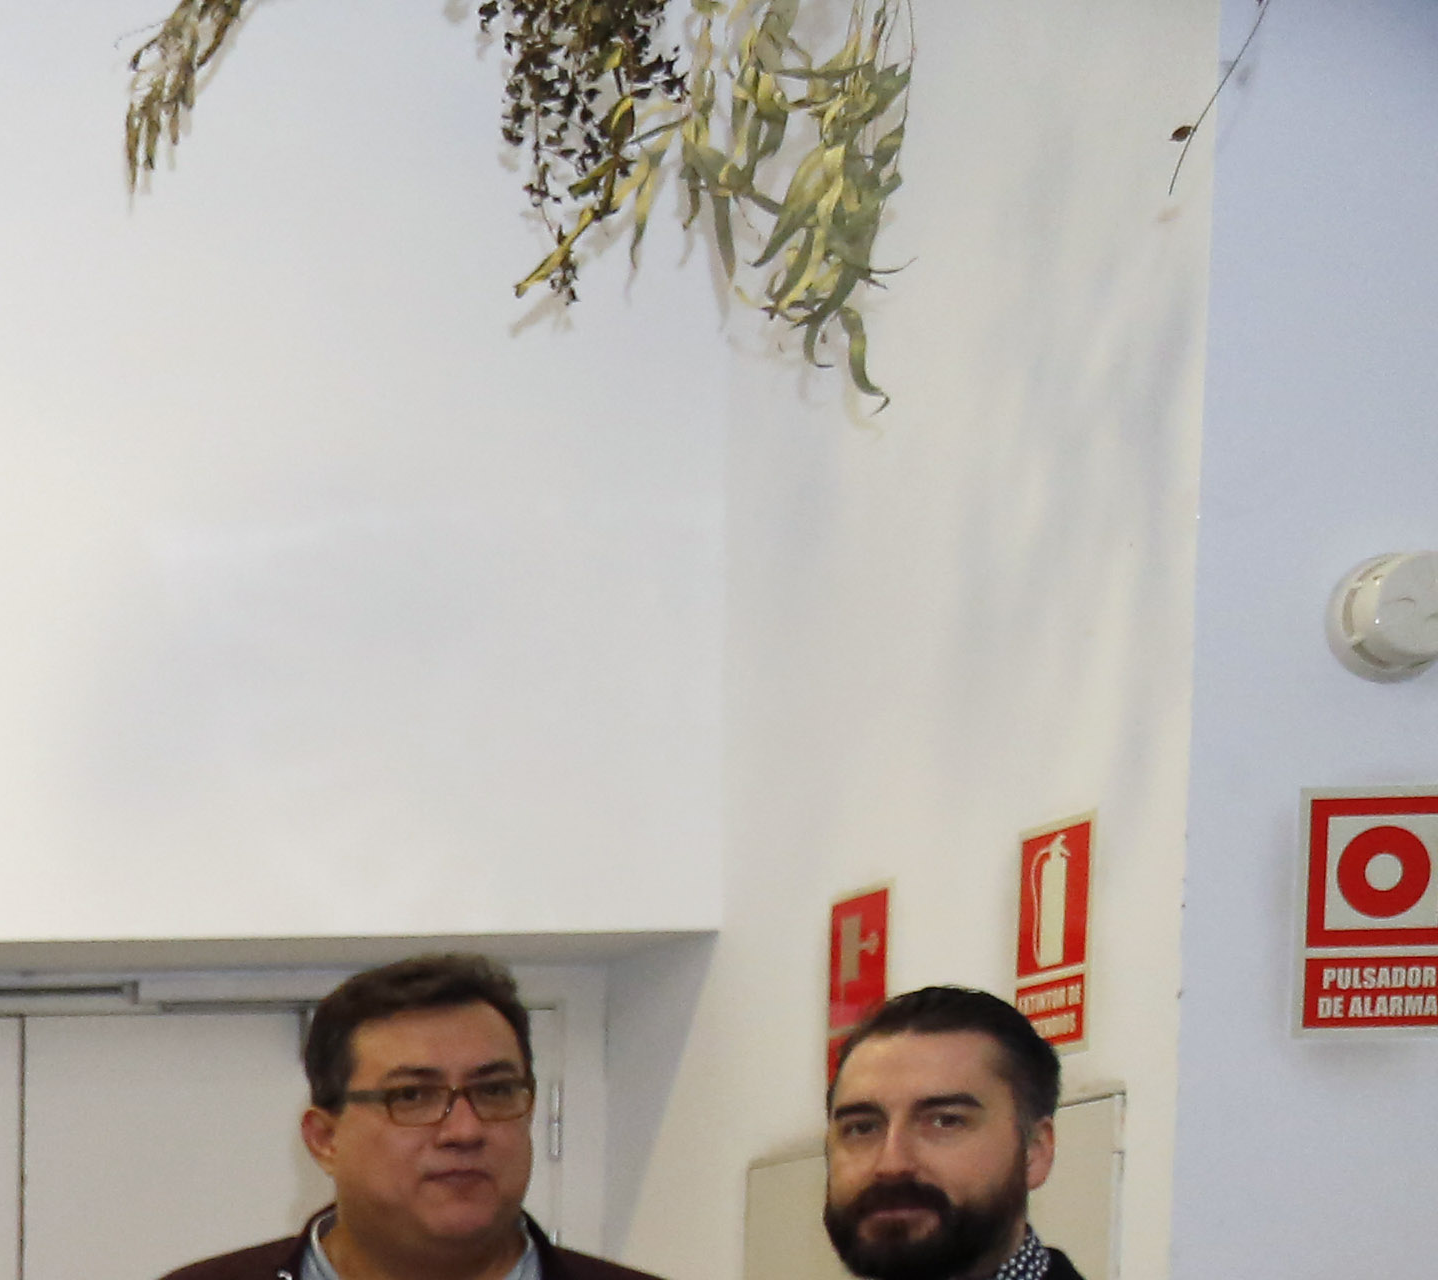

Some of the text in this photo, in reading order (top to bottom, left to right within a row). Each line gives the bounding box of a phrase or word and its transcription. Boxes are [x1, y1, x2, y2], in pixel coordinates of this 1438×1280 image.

[1323, 966, 1437, 990] PULSADOR
[1318, 994, 1438, 1018] DE ALARMA
